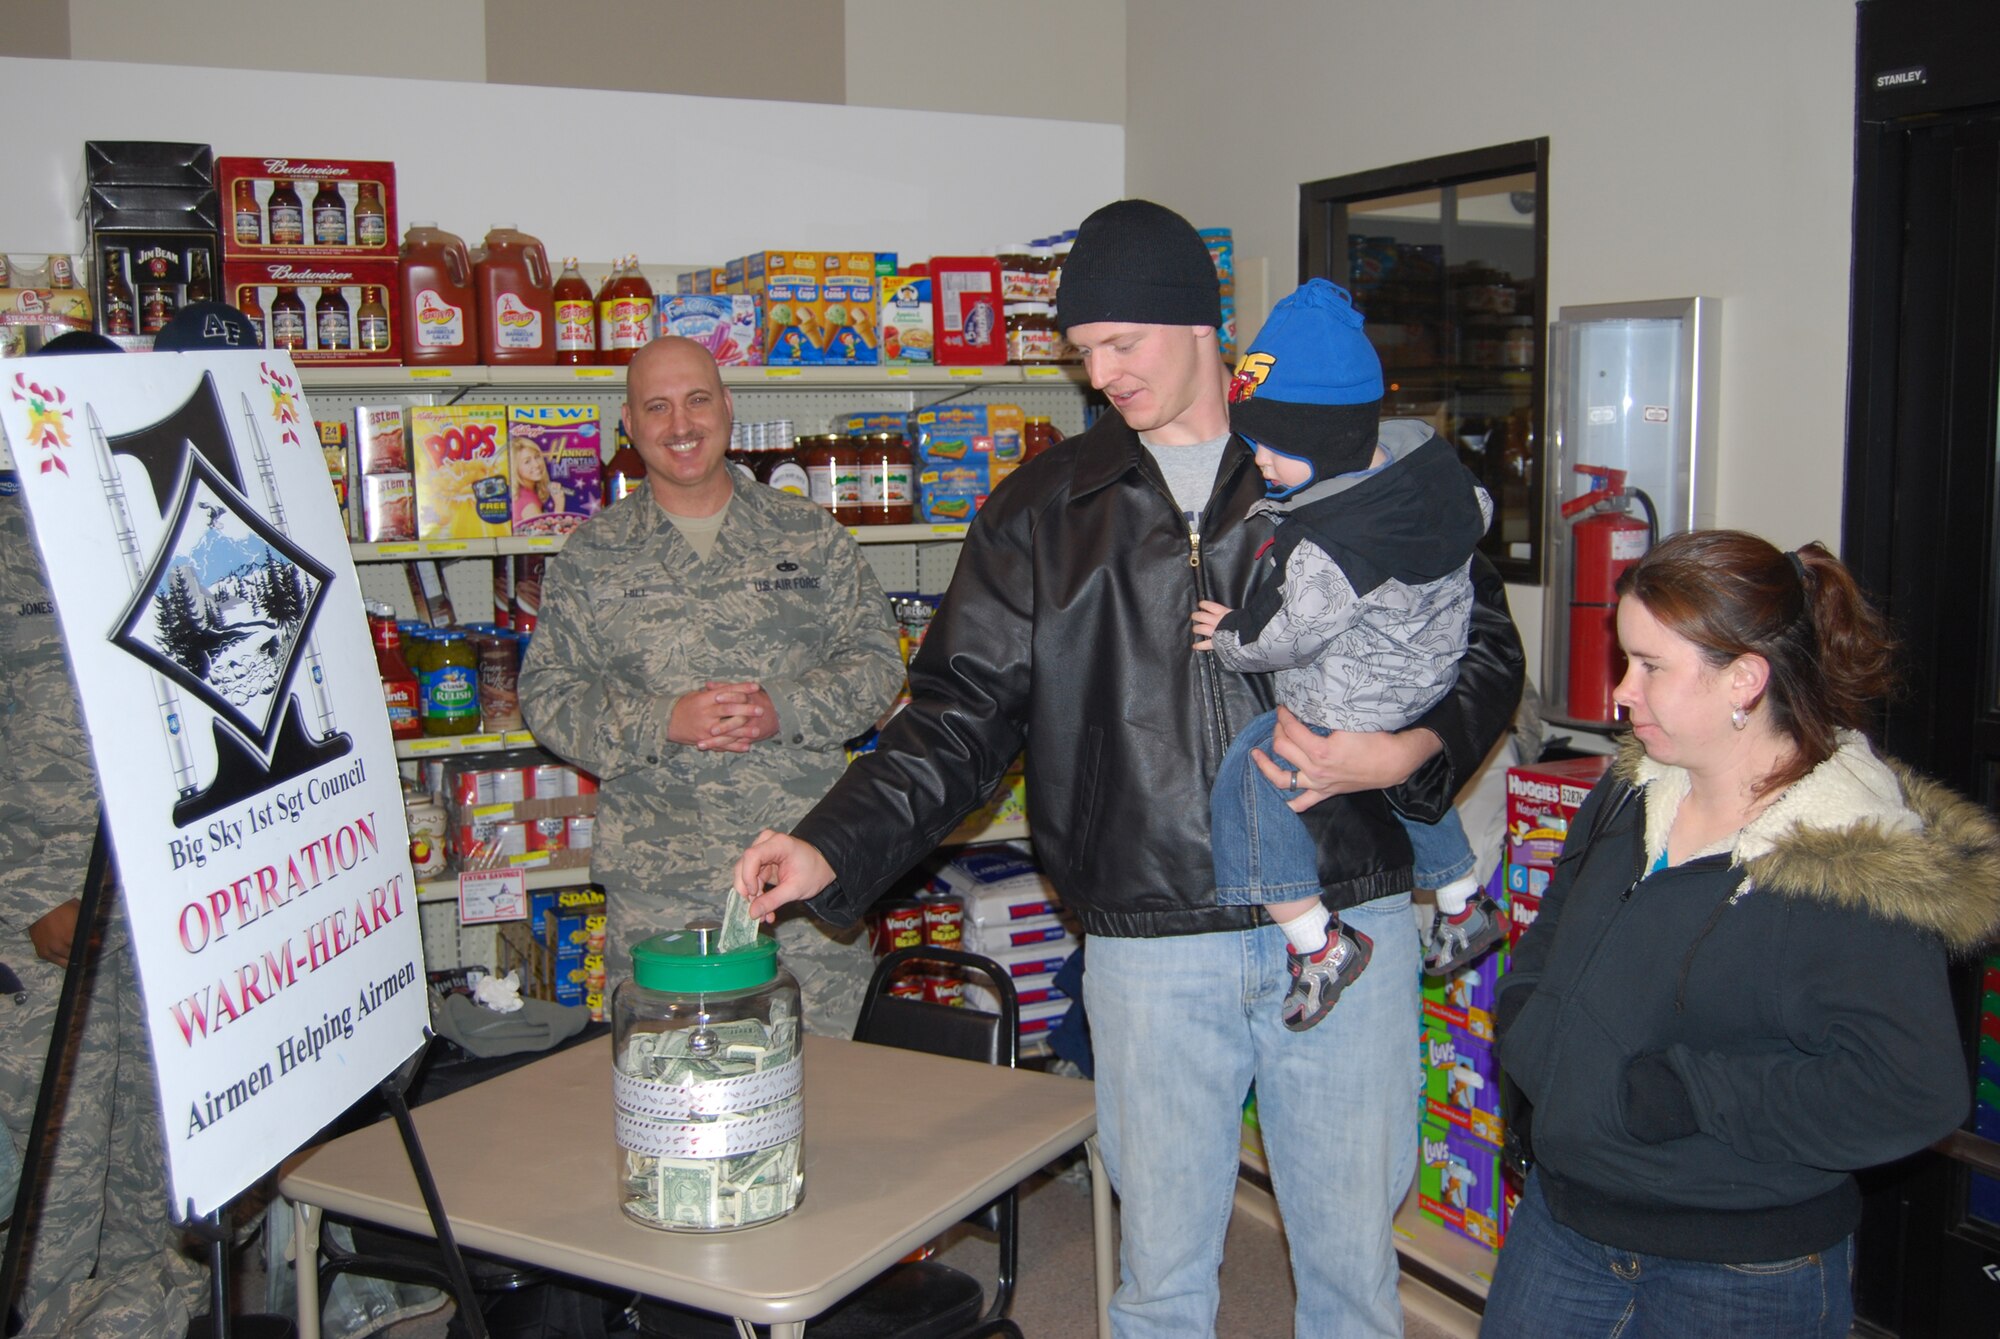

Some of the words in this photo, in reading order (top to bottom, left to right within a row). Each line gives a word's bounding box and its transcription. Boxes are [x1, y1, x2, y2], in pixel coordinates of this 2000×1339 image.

[1877, 70, 1922, 87] STANLEY
[264, 159, 350, 175] Budweiser
[138, 250, 155, 264] JIM
[155, 247, 179, 264] BEAM
[267, 264, 353, 280] Budweiser
[1004, 272, 1034, 284] nutella
[6, 314, 30, 322] STEAK
[1022, 331, 1053, 342] nutella
[515, 407, 593, 419] NEW!
[325, 426, 337, 435] 24
[512, 424, 546, 438] Kellogg's
[423, 424, 497, 470] POPS
[545, 435, 596, 464] HANNAH
[551, 457, 598, 477] MONTANA
[480, 502, 507, 511] FREE
[754, 580, 773, 592] U.S.
[775, 579, 792, 590] AIR
[793, 577, 820, 589] FORCE
[624, 588, 648, 598] HILL
[18, 601, 54, 616] JONES
[385, 690, 408, 701] unt's
[436, 690, 471, 701] RELISH
[1508, 774, 1560, 803] HUGGIES
[169, 834, 204, 871] Big
[211, 818, 244, 851] Sky
[248, 803, 273, 834] 1st
[277, 791, 305, 823] Sgt
[308, 758, 367, 806] Council
[463, 873, 487, 881] EXTRA
[489, 871, 519, 880] SAVINGS
[1512, 869, 1523, 889] 6
[178, 812, 380, 956] OPERATION
[559, 891, 605, 908] SPAM
[585, 916, 607, 933] SP
[895, 936, 921, 948] BEANS
[931, 929, 960, 941] BEANS
[168, 872, 404, 1048] WARM-HEART
[187, 1061, 274, 1139] Airmen
[276, 1005, 352, 1079] Helping
[357, 960, 416, 1025] Airmen
